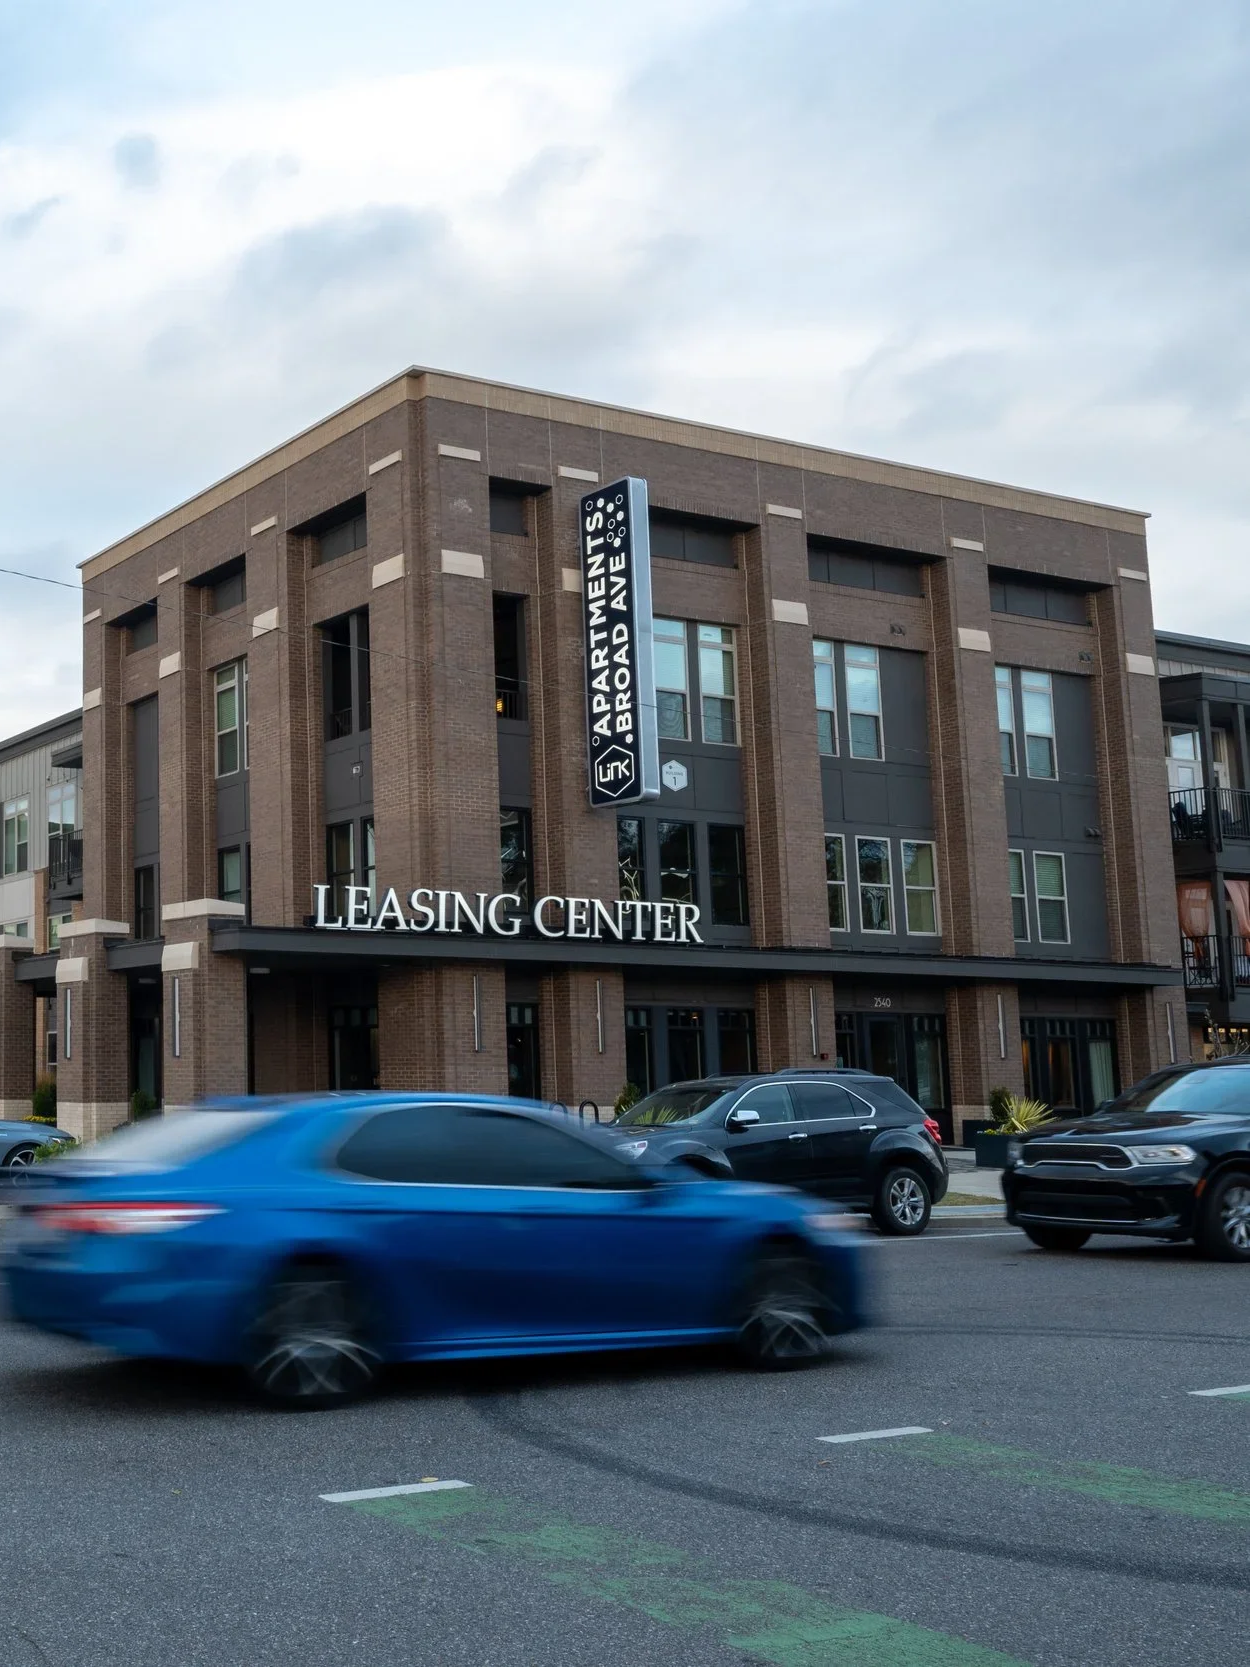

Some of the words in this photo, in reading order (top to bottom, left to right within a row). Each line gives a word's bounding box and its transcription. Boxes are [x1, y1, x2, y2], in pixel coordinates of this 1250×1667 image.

[609, 552, 627, 611] AVE
[585, 511, 612, 737] APARTMENTS
[612, 622, 632, 733] BROAD
[672, 776, 677, 786] 1
[313, 884, 522, 936] LEASING
[534, 896, 704, 944] CENTER
[873, 997, 892, 1008] 2540
